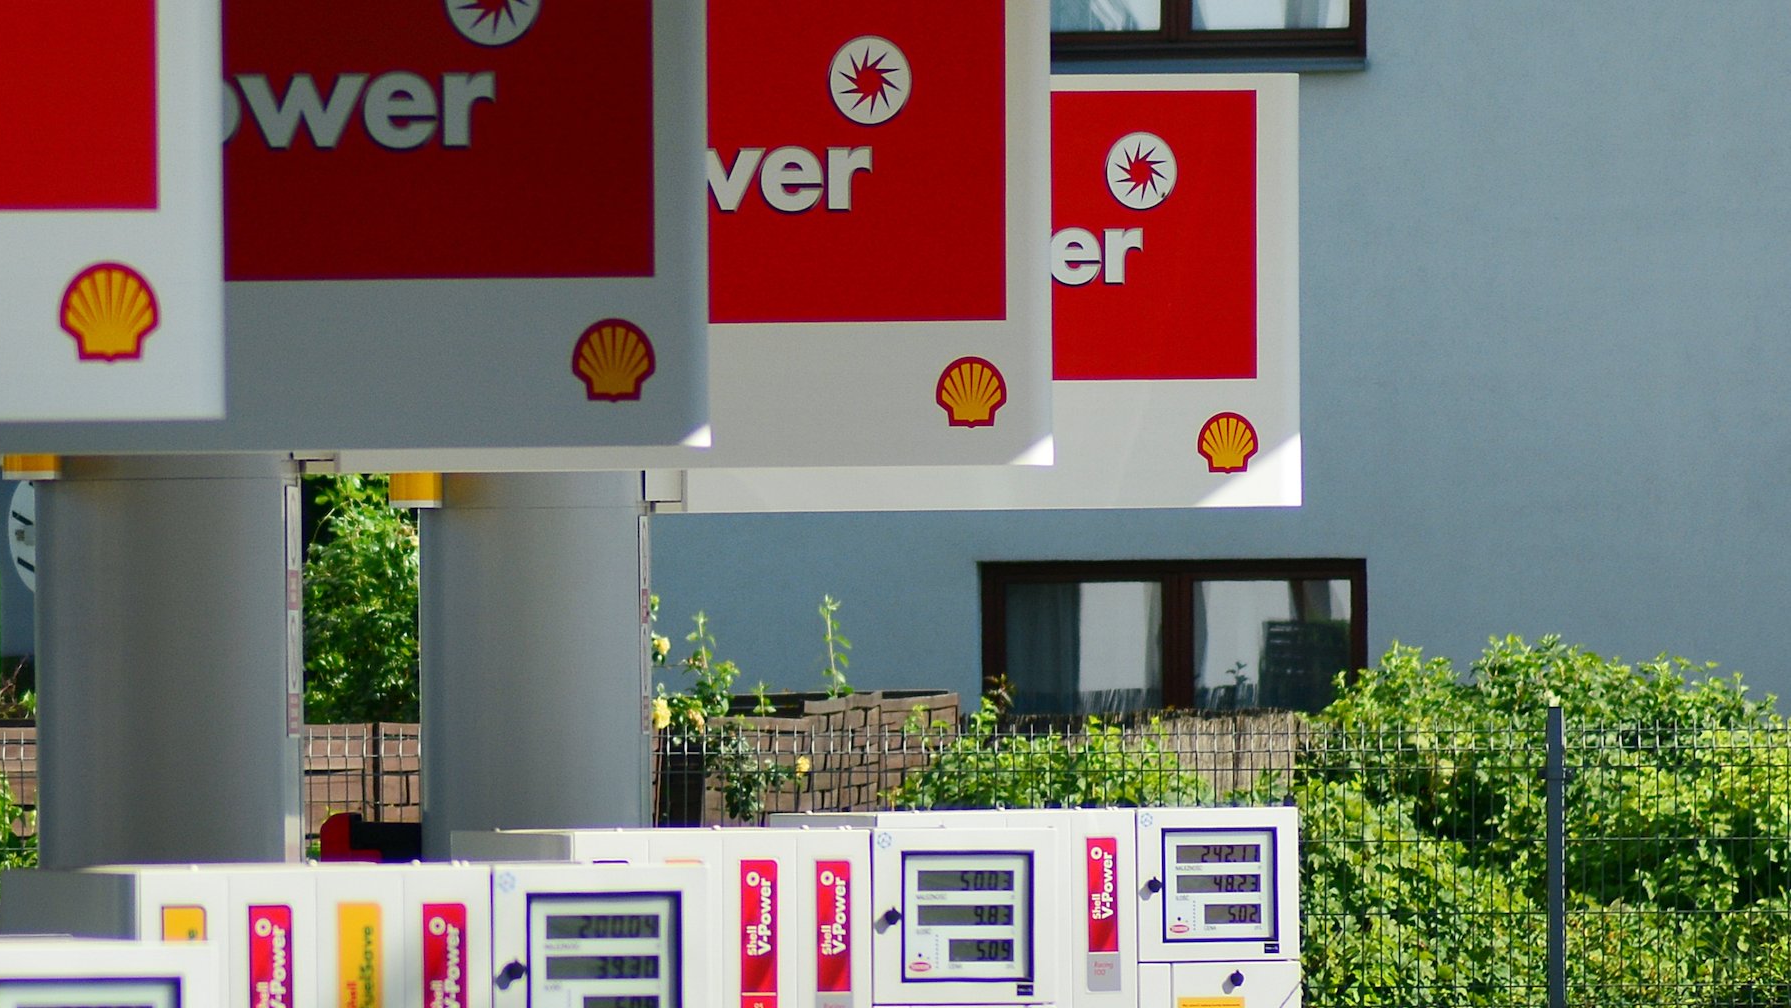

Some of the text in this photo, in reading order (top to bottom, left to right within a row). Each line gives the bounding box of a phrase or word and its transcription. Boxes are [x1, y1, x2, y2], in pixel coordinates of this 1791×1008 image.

[1091, 893, 1102, 920] Shell
[1102, 851, 1114, 919] V-Power
[746, 925, 758, 956] Shell
[758, 877, 772, 956] V-Power
[820, 924, 833, 956] Shell
[833, 876, 847, 955] V-Power
